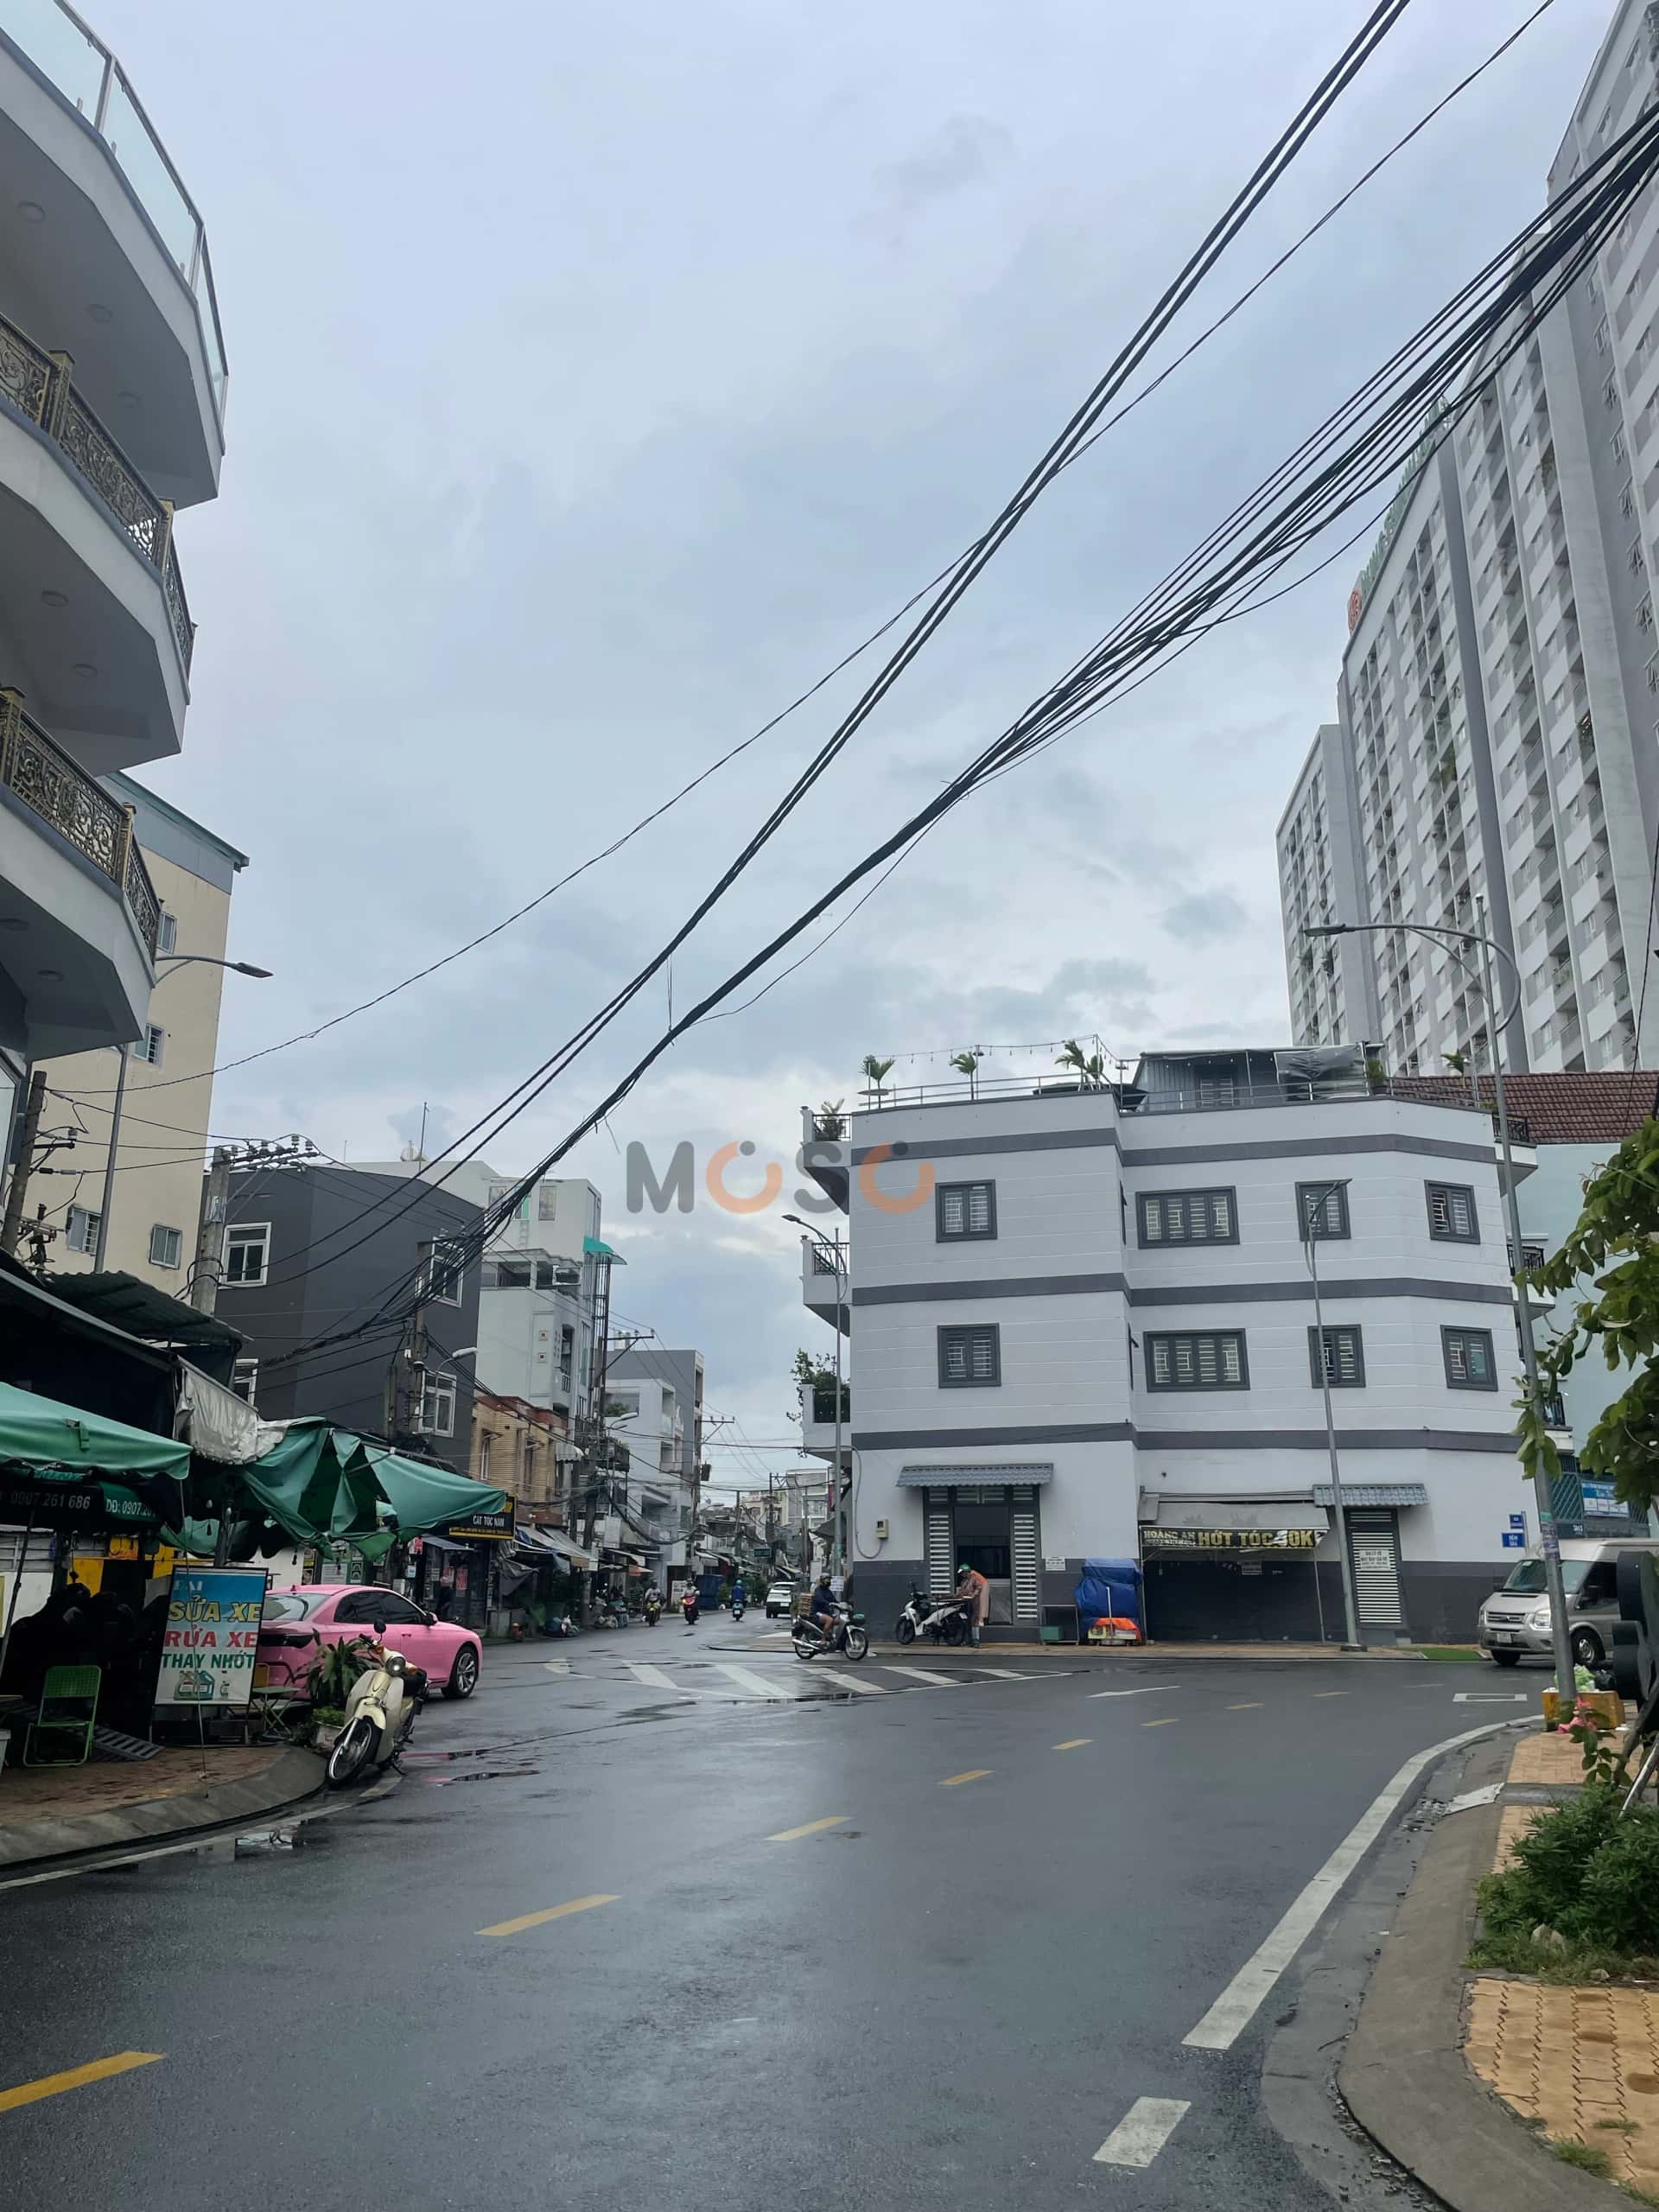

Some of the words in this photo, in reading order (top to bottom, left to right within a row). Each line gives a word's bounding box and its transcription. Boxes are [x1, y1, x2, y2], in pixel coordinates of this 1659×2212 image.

[68, 1495, 91, 1510] 686
[1198, 1529, 1232, 1546] HỚT
[1237, 1529, 1274, 1547] TÓC
[168, 1594, 221, 1623] SỬA
[227, 1601, 263, 1623] XE
[163, 1624, 217, 1648] RỬA
[226, 1630, 258, 1648] XE
[162, 1653, 206, 1669] THAY
[211, 1649, 255, 1669] NHỚT
